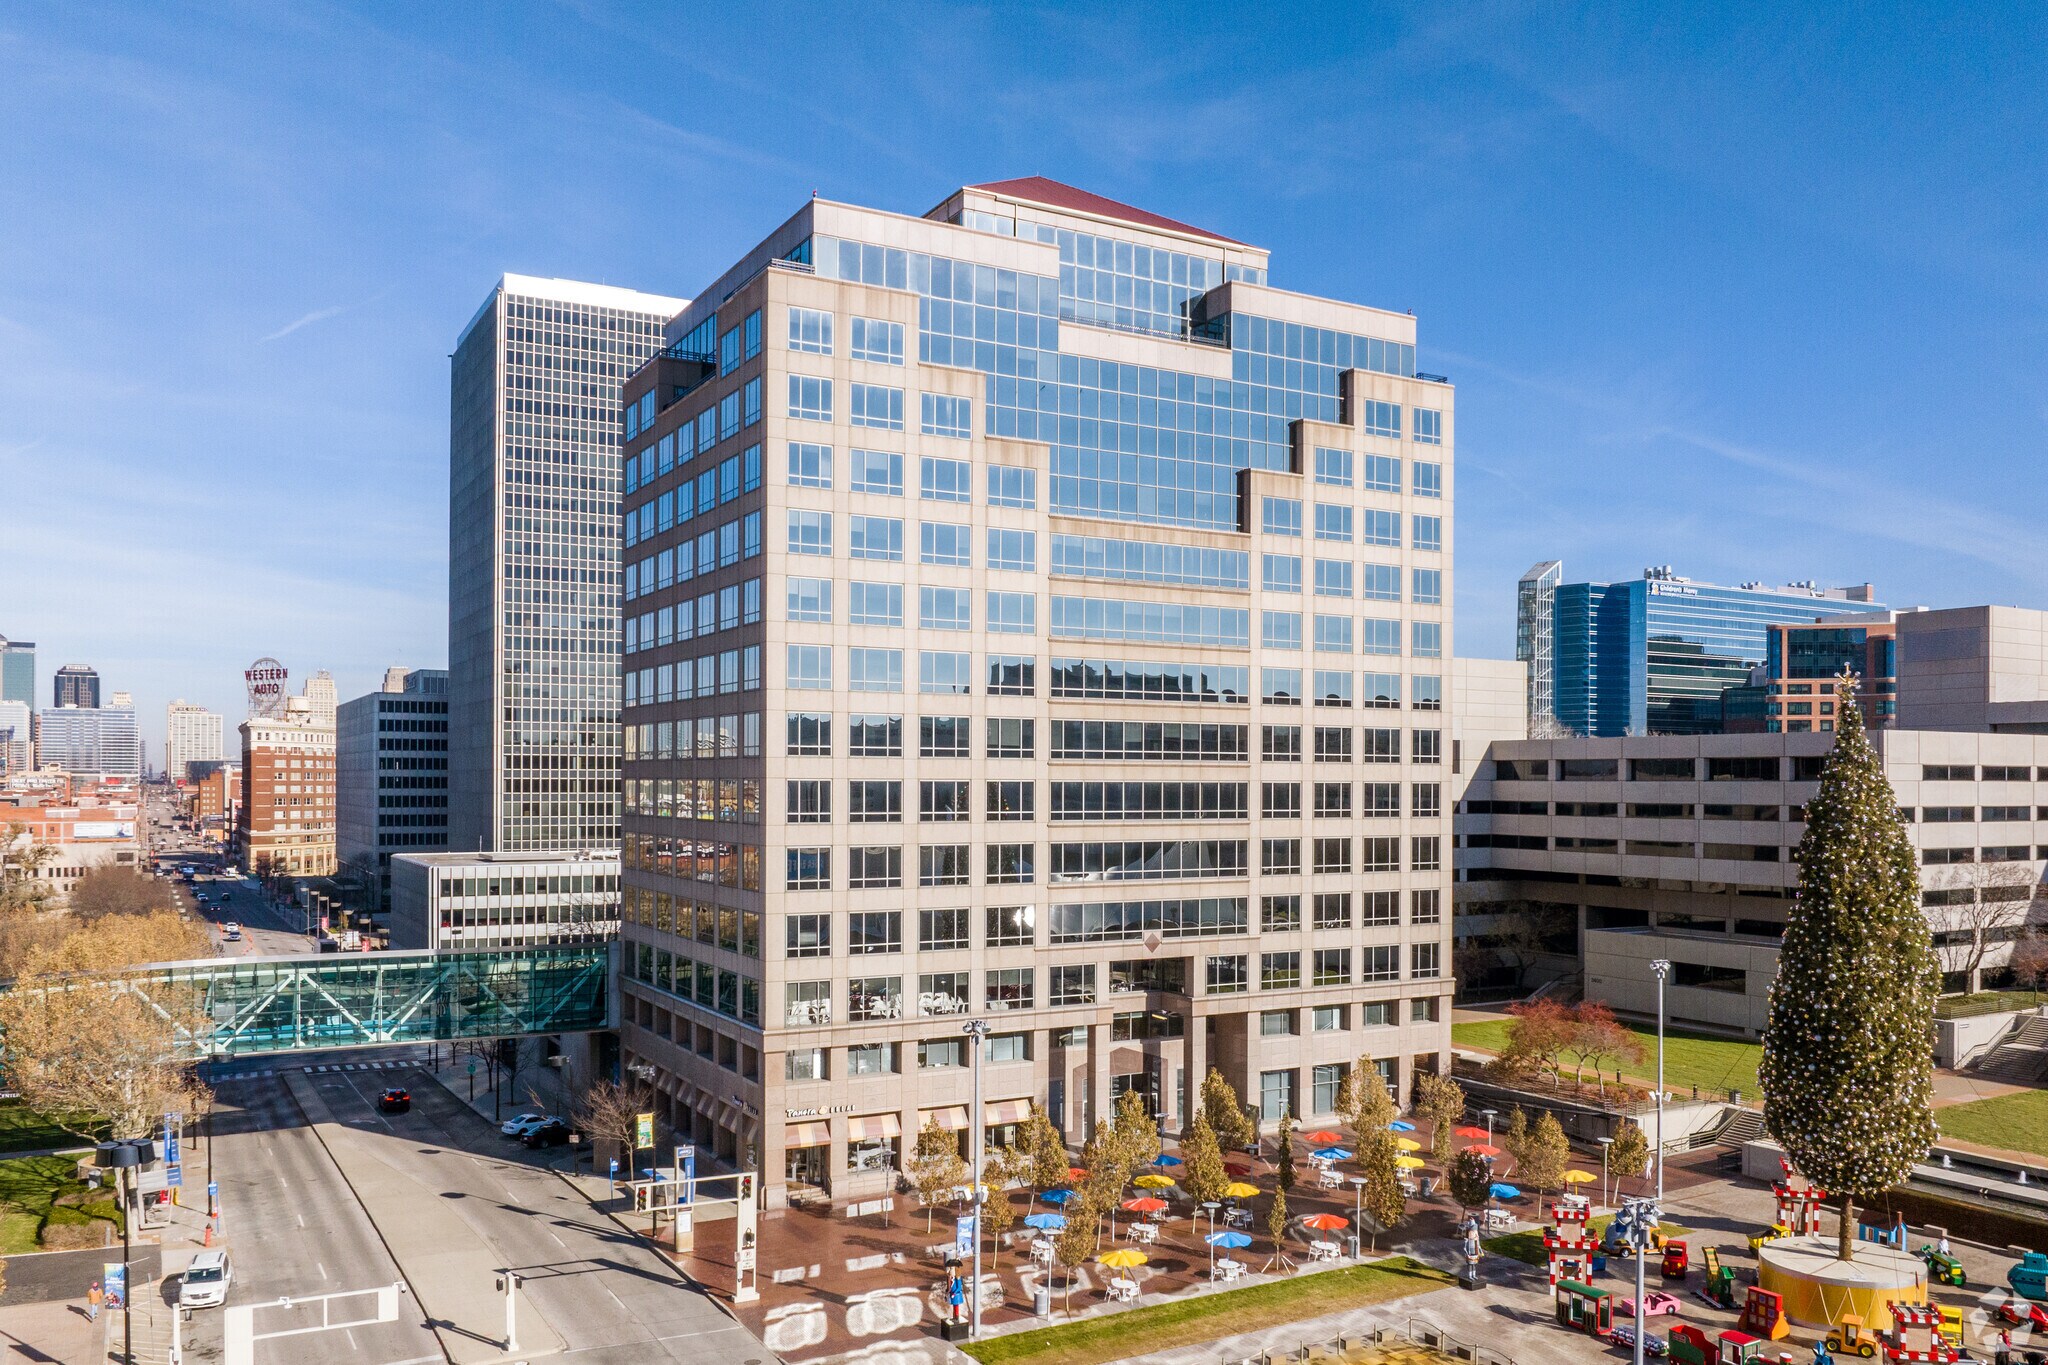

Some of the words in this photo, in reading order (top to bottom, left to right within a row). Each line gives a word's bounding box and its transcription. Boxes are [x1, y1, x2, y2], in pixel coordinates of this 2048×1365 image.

[245, 668, 288, 681] WESTERN
[254, 683, 279, 695] AUTO
[786, 1109, 816, 1118] Panera
